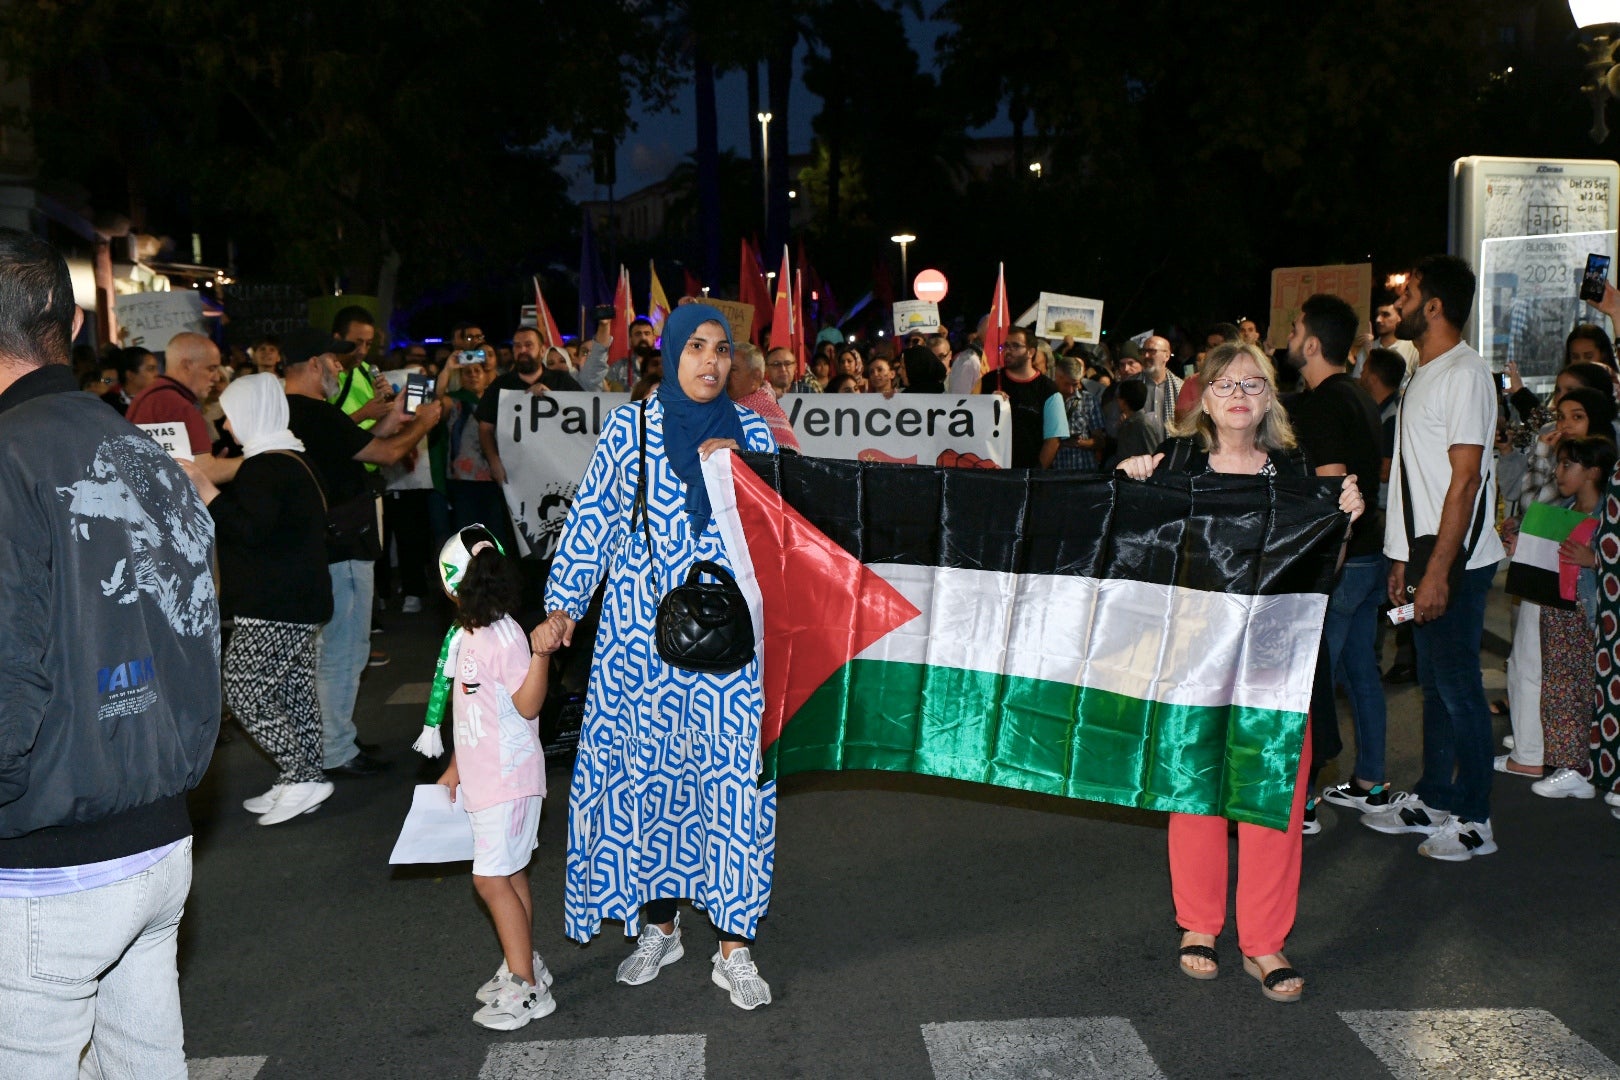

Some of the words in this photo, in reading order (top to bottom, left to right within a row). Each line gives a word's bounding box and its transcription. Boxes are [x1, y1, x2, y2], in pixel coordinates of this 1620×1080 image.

[1524, 264, 1567, 283] 2023
[513, 395, 601, 442] ¡Pal
[145, 427, 176, 437] OYAS
[163, 443, 176, 451] EL
